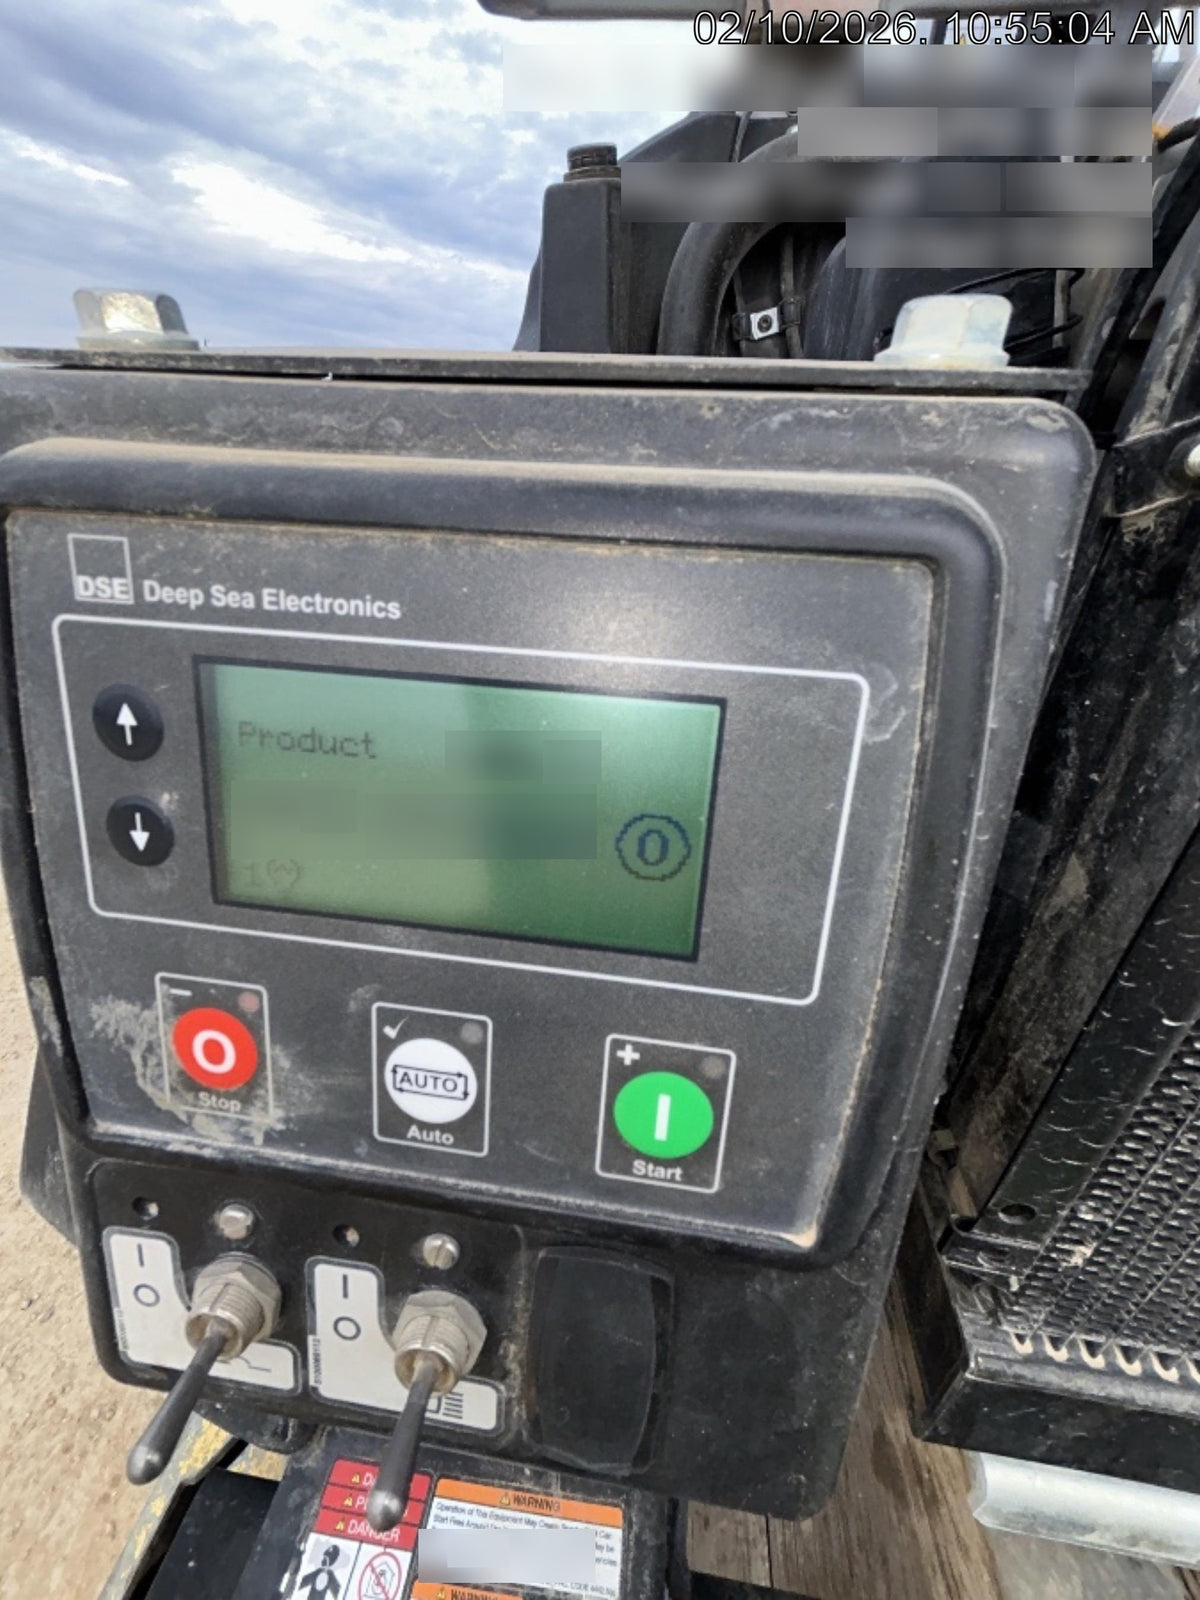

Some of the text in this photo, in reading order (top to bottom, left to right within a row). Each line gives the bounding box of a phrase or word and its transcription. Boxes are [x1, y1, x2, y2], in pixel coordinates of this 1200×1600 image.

[76, 575, 401, 620] DSE Deep Sea Electronics
[238, 721, 378, 760] Product
[400, 1071, 458, 1093] AUTO
[198, 1091, 241, 1114] Stop
[406, 1124, 454, 1146] Auto
[632, 1159, 682, 1182] Start
[513, 1494, 561, 1513] WARNING
